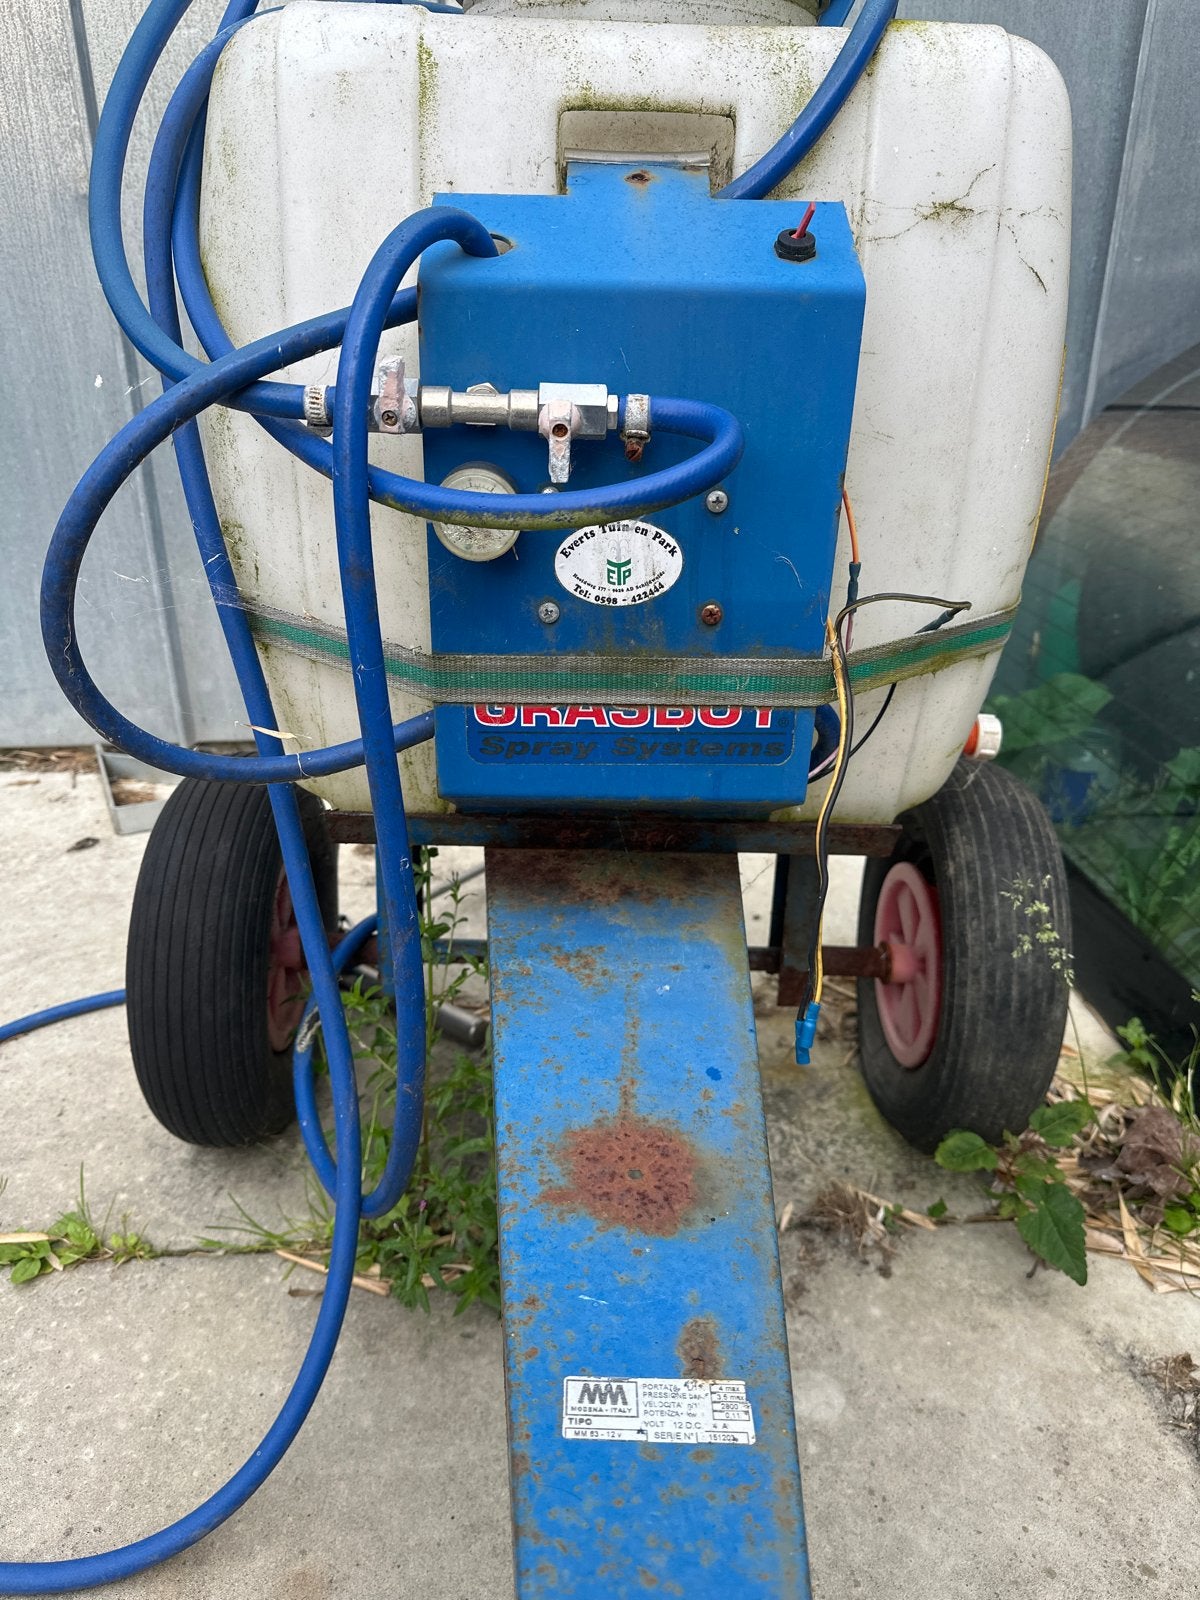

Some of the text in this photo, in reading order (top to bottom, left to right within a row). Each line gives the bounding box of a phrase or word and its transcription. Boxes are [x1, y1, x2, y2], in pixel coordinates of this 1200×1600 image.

[560, 528, 596, 558] Everts
[634, 526, 648, 536] en
[652, 530, 678, 557] Park
[573, 584, 592, 598] Tel:
[594, 595, 618, 605] 0598
[630, 582, 664, 603] 422444
[480, 736, 786, 760] Spray Systems
[654, 1432, 682, 1440] SERIE
